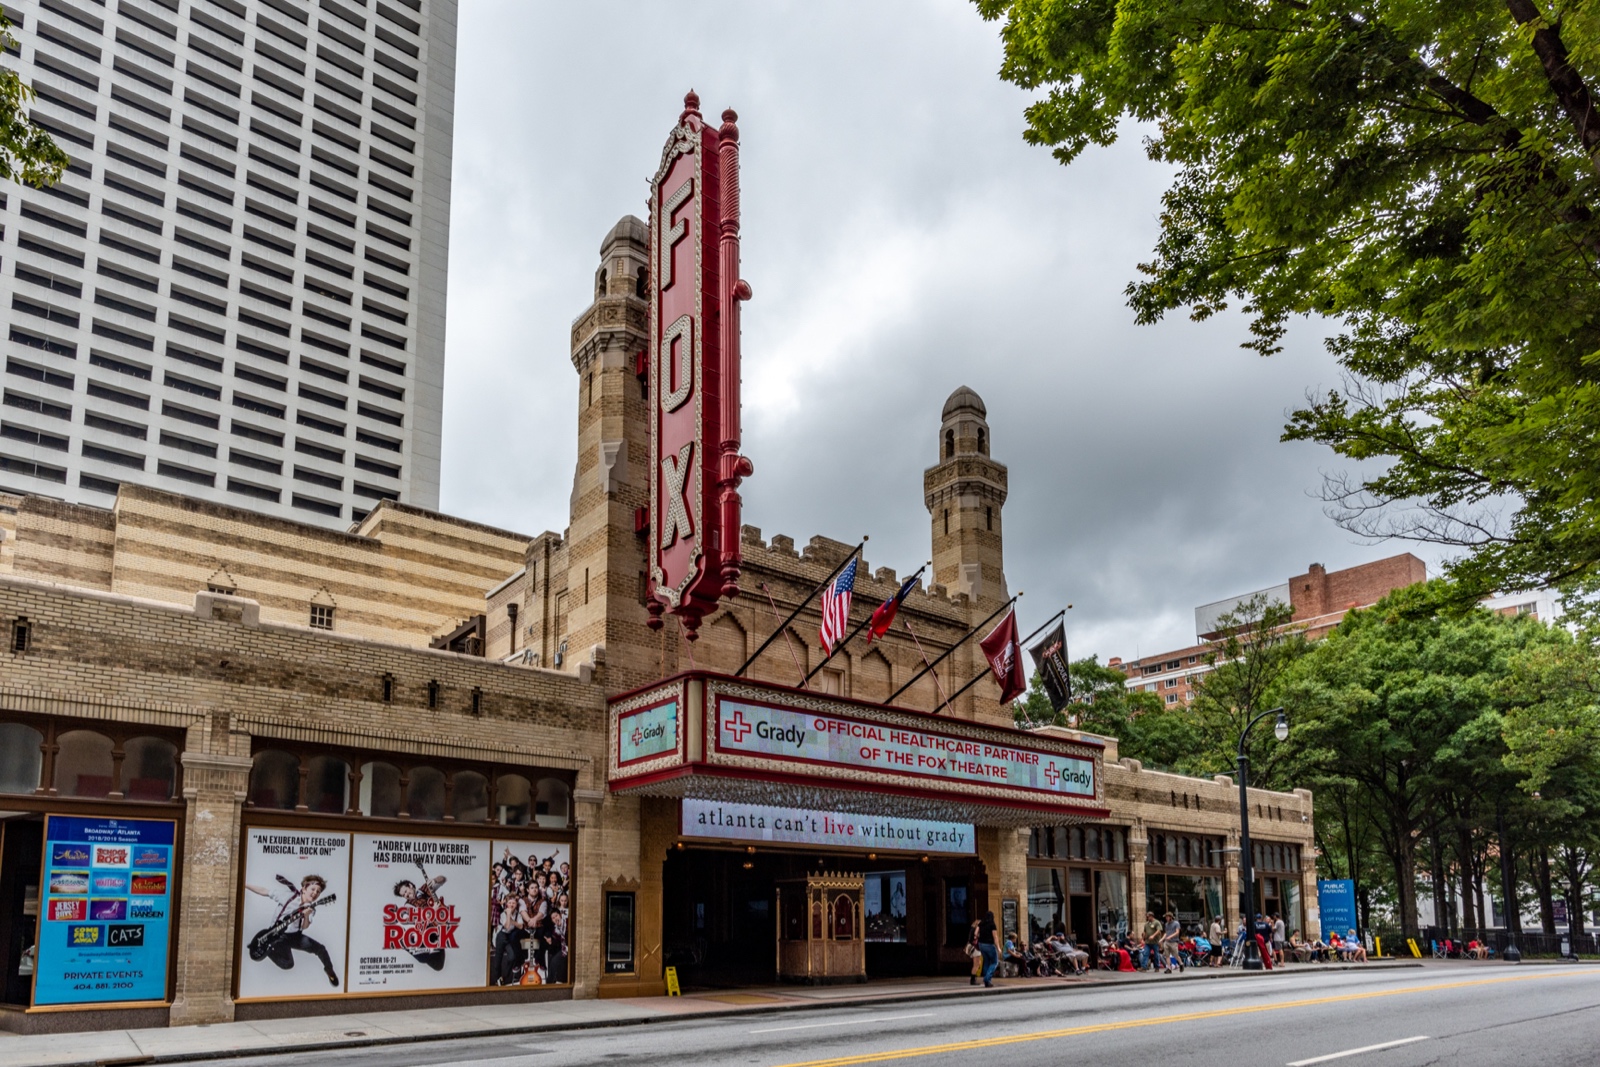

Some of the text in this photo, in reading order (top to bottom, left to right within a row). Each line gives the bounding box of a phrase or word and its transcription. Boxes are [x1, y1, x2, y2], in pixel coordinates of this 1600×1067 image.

[660, 177, 694, 551] FOX
[643, 722, 666, 740] Grady
[755, 718, 1091, 788] Grady OFFICIAL HEALTHCARE PARTNER Grady
[859, 746, 1008, 779] OF THE FOX THEATRE
[698, 807, 965, 848] atlanta can't live without grady
[253, 834, 346, 847] “AN EXUBERANT FEEL-GOOD
[372, 840, 469, 854] “ANDREW LLOYD WEBBER
[263, 845, 298, 855] MUSICAL.
[299, 846, 318, 856] ROCK
[96, 855, 127, 864] ROCK
[373, 852, 477, 866] HAS BROADWAY ROCKING!”
[55, 901, 80, 911] JERSEY
[131, 911, 164, 919] HANSEN
[382, 903, 461, 925] SCHOOL
[110, 927, 142, 944] CATS
[382, 925, 460, 950] ROCK
[360, 956, 383, 964] OCTOBER
[64, 970, 144, 980] PRIVATE EVENTS
[112, 981, 134, 989] 2100
